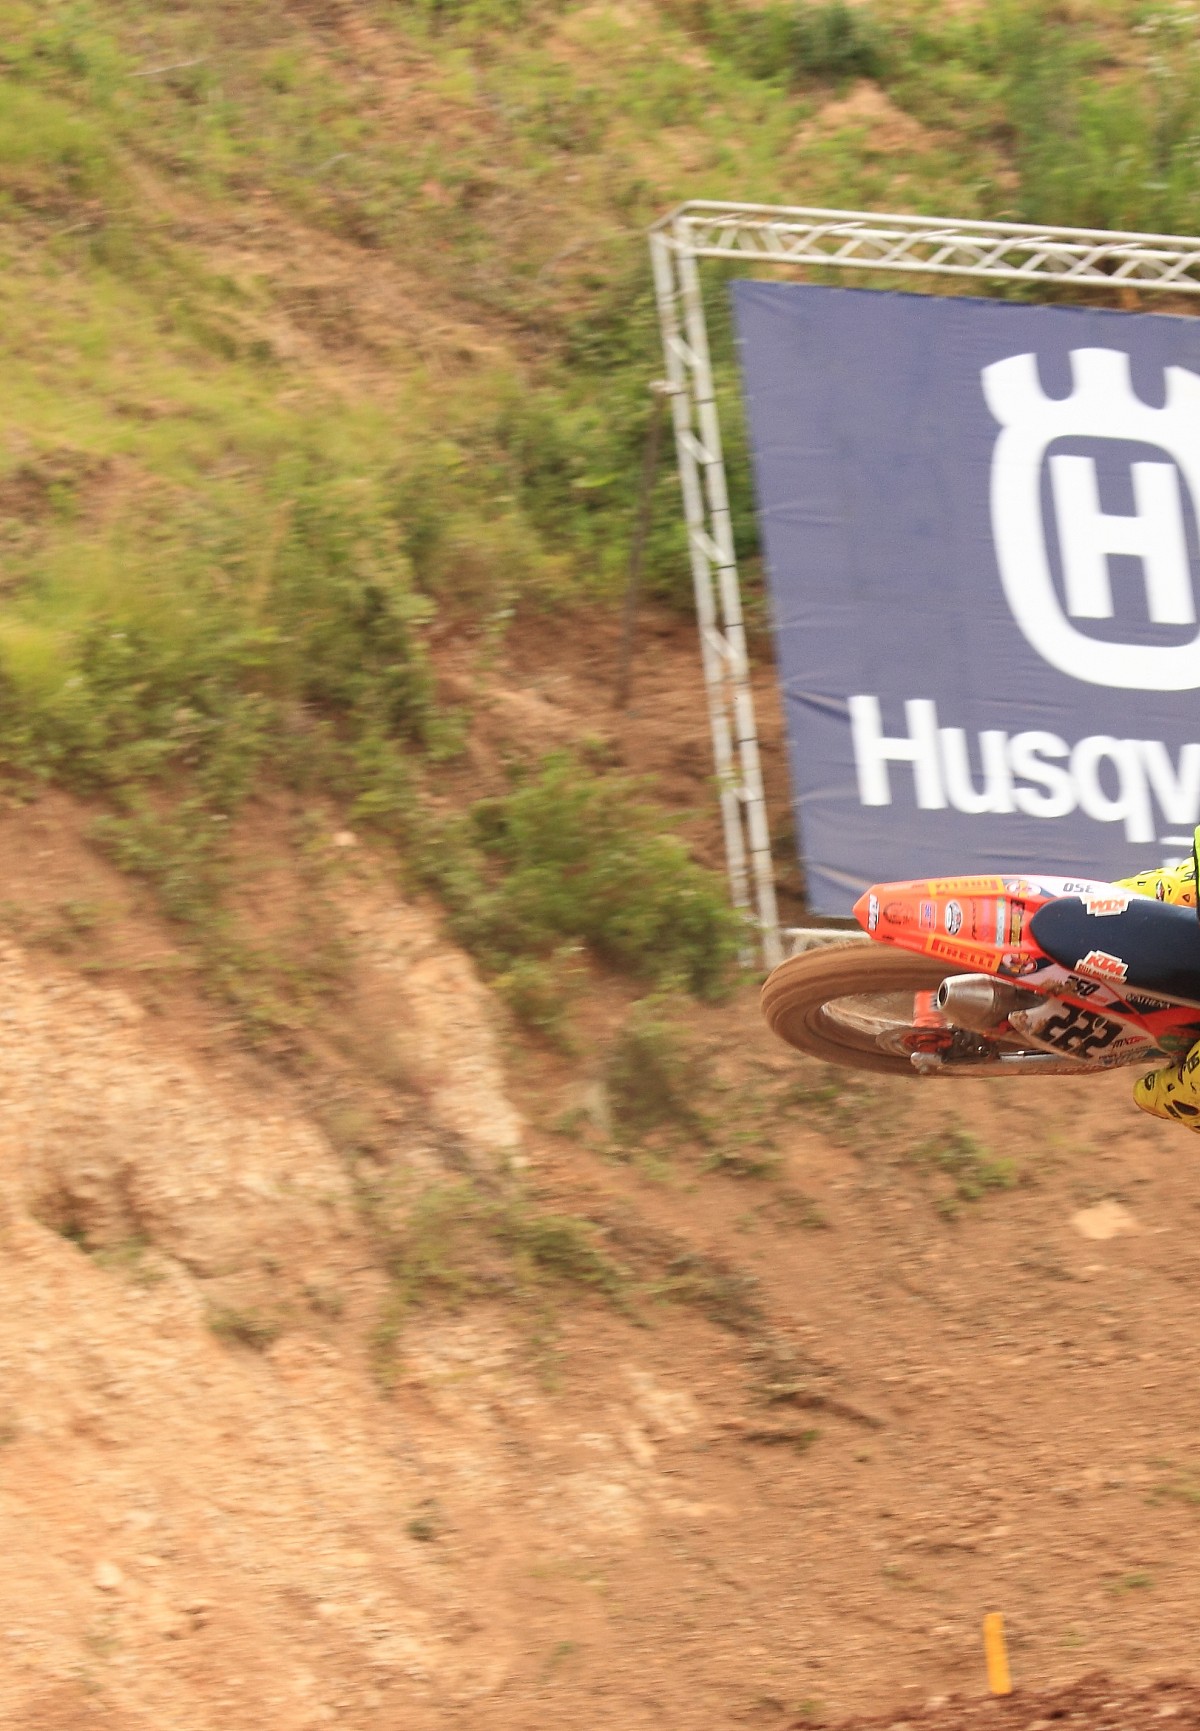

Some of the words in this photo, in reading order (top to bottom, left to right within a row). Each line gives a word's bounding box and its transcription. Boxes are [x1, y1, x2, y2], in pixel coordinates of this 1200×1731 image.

[1089, 898, 1127, 913] KTM
[931, 938, 996, 968] PIRELLI
[1087, 953, 1128, 977] KTM
[1132, 993, 1171, 1010] ATHENA
[1038, 1001, 1124, 1059] 222
